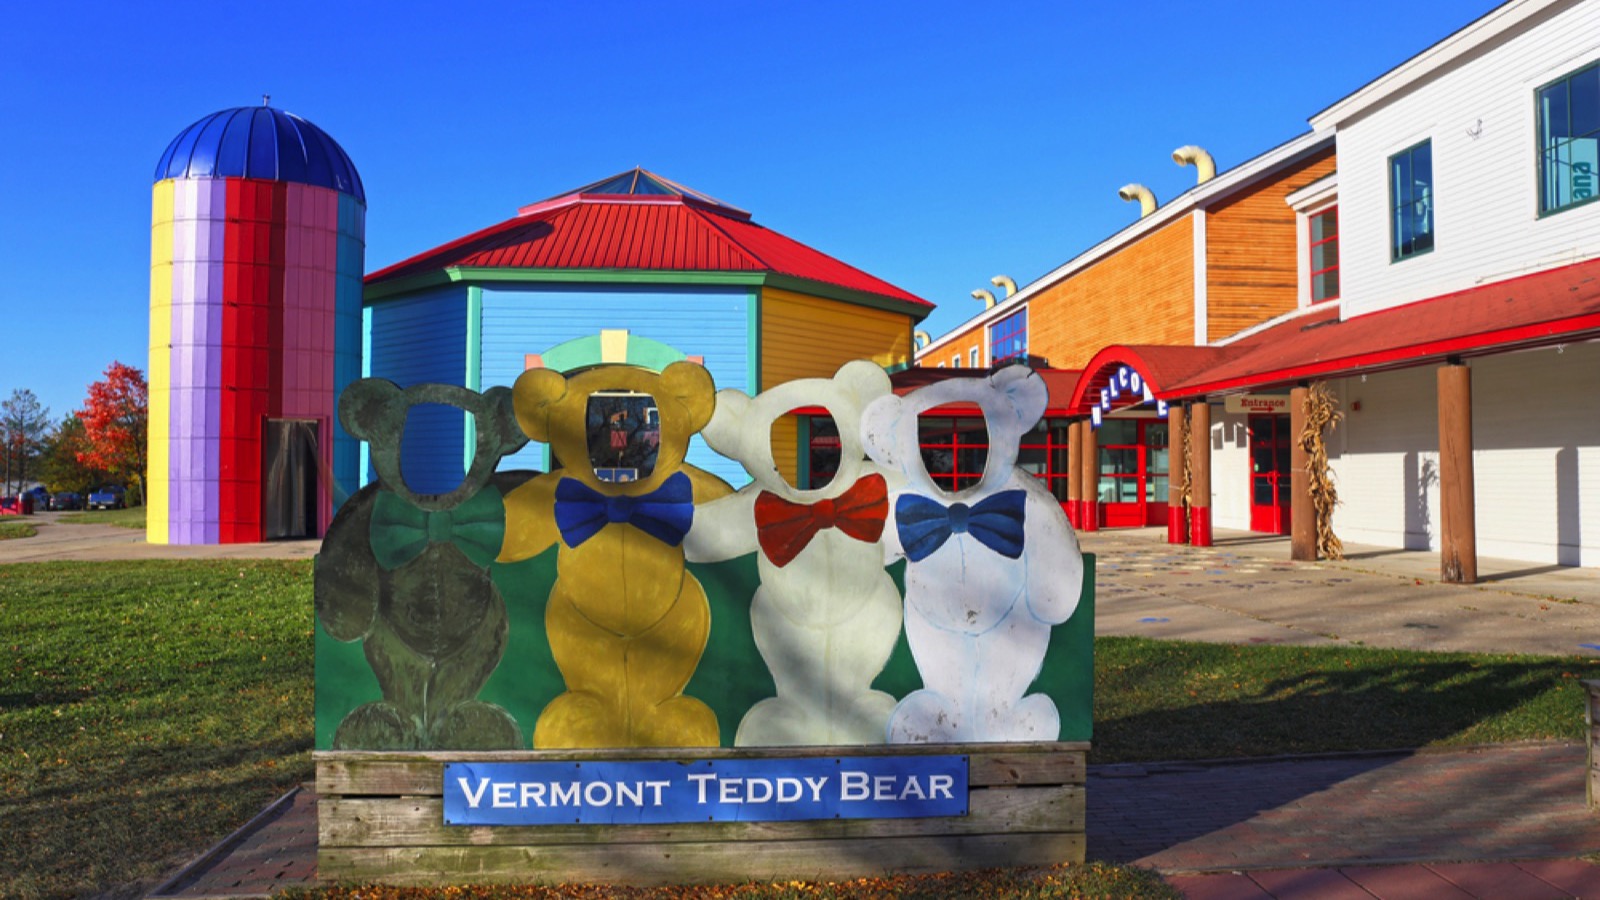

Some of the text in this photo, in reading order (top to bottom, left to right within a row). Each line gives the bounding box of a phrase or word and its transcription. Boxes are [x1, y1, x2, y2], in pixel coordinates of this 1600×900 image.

[1240, 398, 1286, 408] Entrance
[457, 771, 955, 809] VERMONT TEDDY BEAR
